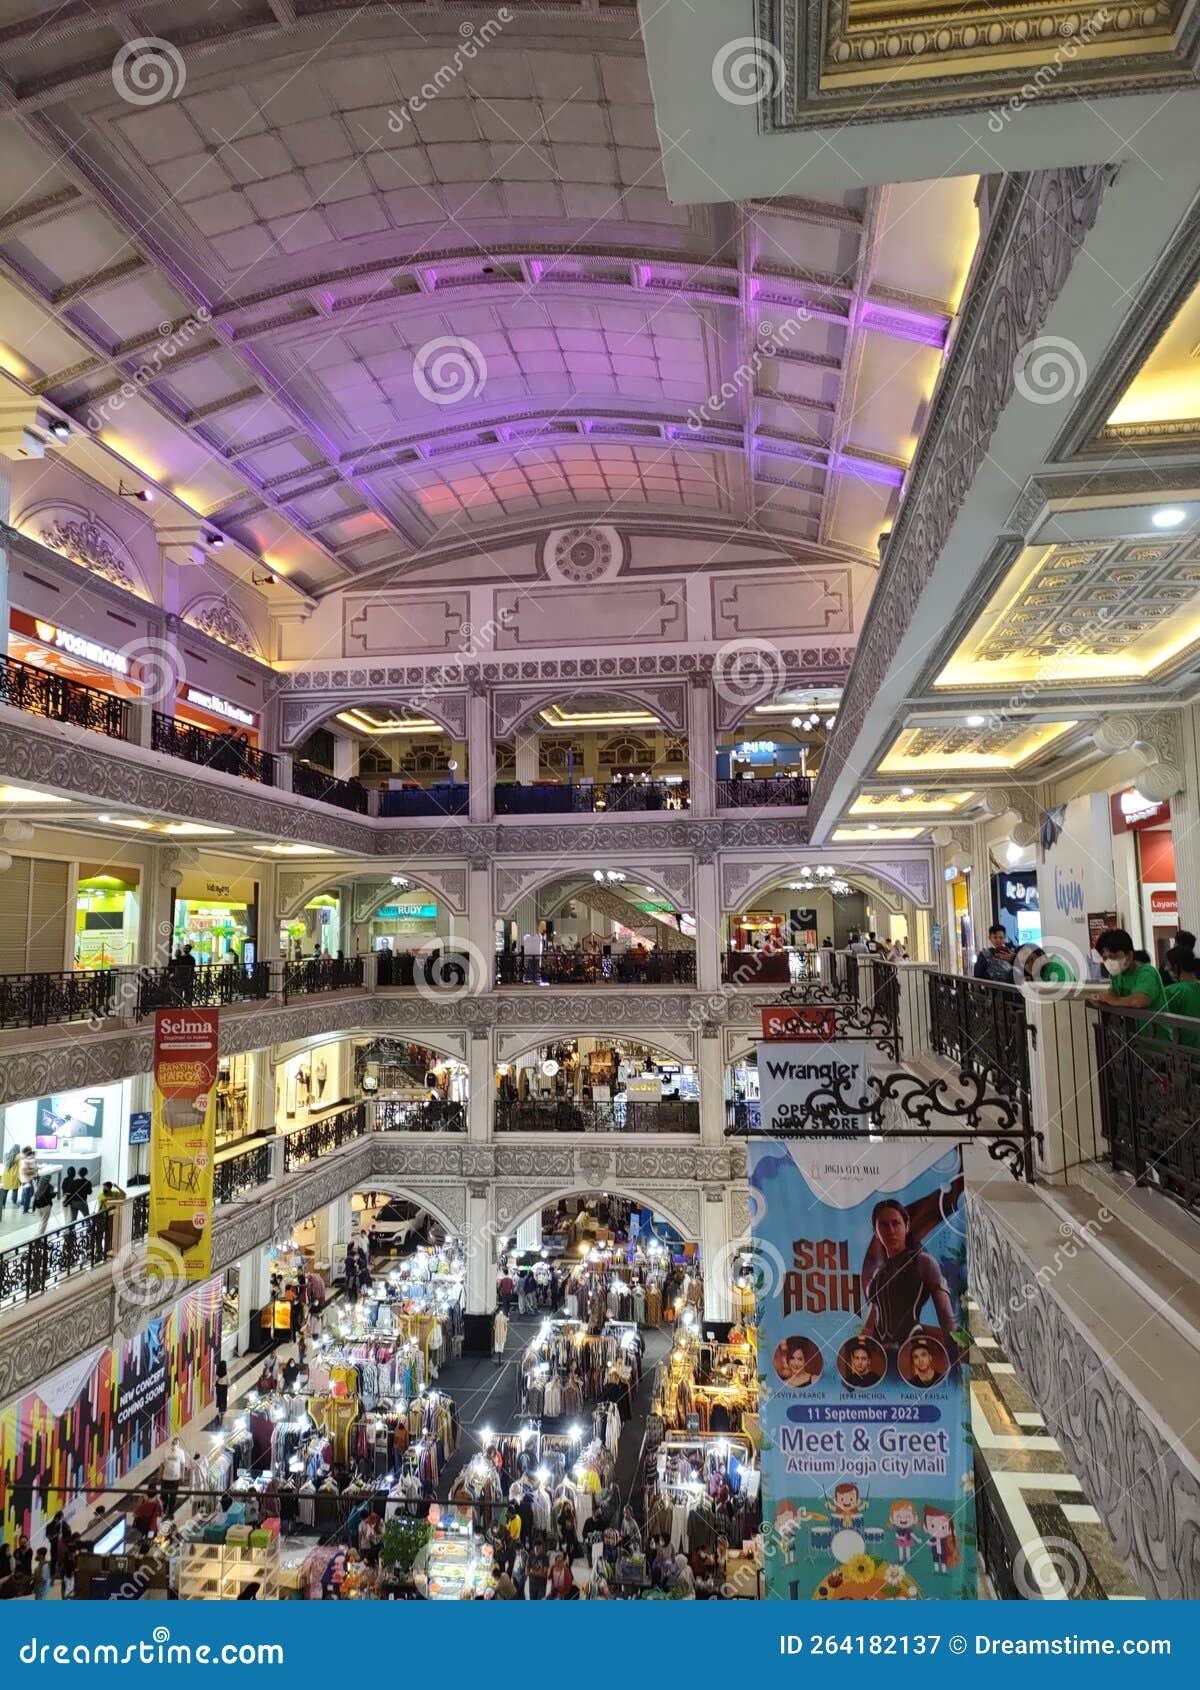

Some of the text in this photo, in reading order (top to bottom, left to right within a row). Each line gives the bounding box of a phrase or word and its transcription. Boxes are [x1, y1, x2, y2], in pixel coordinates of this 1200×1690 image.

[160, 1018, 212, 1035] Selma
[766, 1060, 859, 1089] Wrangler
[792, 1238, 849, 1271] SRI
[783, 1271, 862, 1319] ASIH
[807, 1407, 920, 1422] 11 September 2022
[781, 1427, 948, 1453] Meet & Greet
[786, 1458, 945, 1478] Atrium Jogja City Mall
